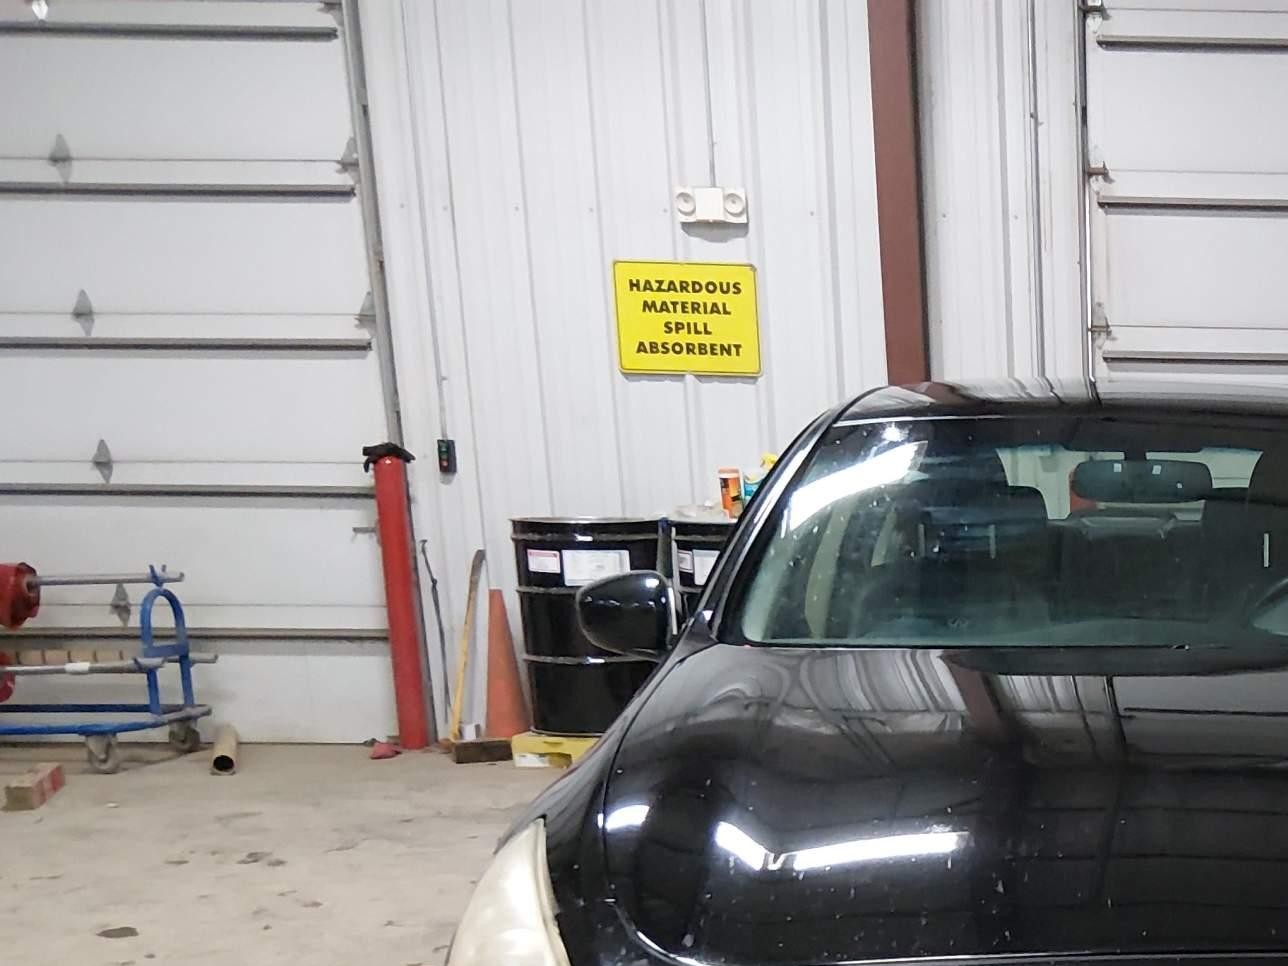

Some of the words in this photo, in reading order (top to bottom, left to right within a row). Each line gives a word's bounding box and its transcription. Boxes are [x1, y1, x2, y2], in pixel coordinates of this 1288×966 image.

[628, 279, 742, 294] HAZARDOUS
[642, 300, 731, 315] MATERIAL
[663, 321, 712, 335] SPILL
[636, 341, 742, 356] ABSORBENT
